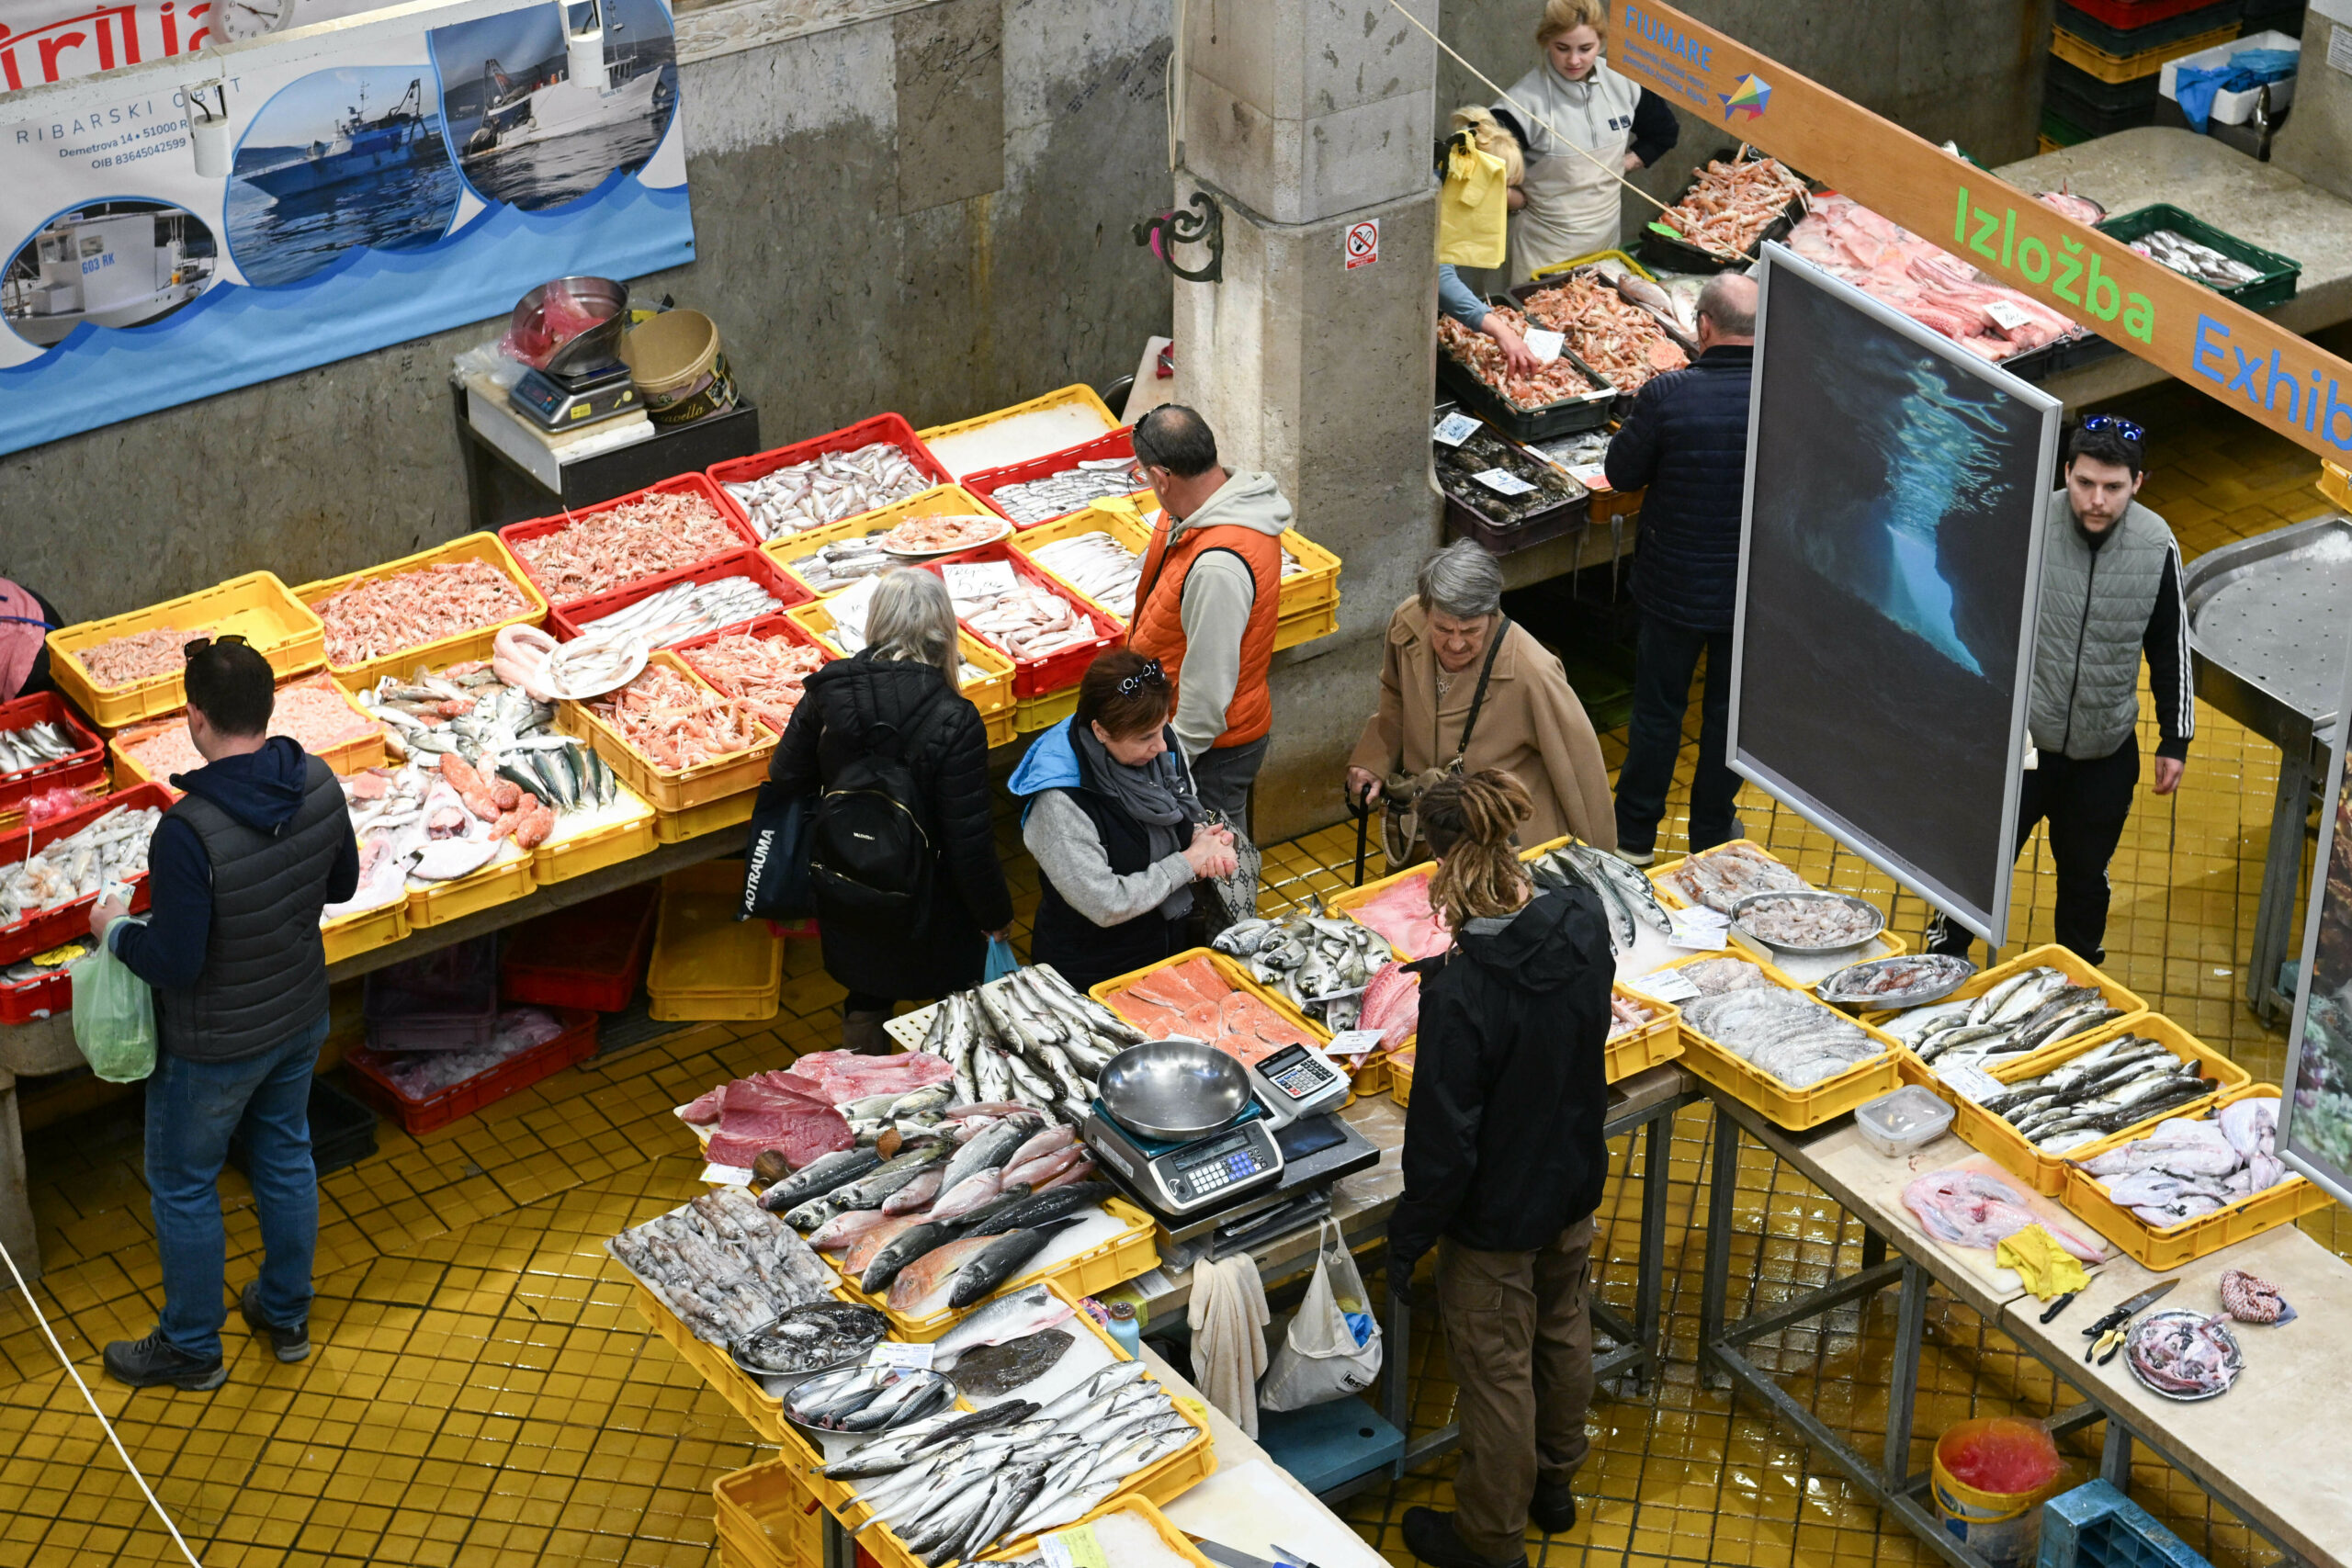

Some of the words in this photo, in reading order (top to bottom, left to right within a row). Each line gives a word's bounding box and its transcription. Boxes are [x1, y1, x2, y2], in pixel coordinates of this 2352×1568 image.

[1624, 5, 1713, 72] FIUMARE
[17, 100, 153, 144] RIBARSKI
[59, 138, 119, 159] Demetrova
[120, 132, 134, 145] 14
[143, 120, 179, 139] 51000
[92, 156, 112, 170] OIB
[115, 138, 187, 166] 83645042599
[82, 257, 100, 276] 603
[102, 252, 115, 268] RK
[1954, 186, 2155, 345] Izložba
[744, 829, 775, 912] AOTRAUMA
